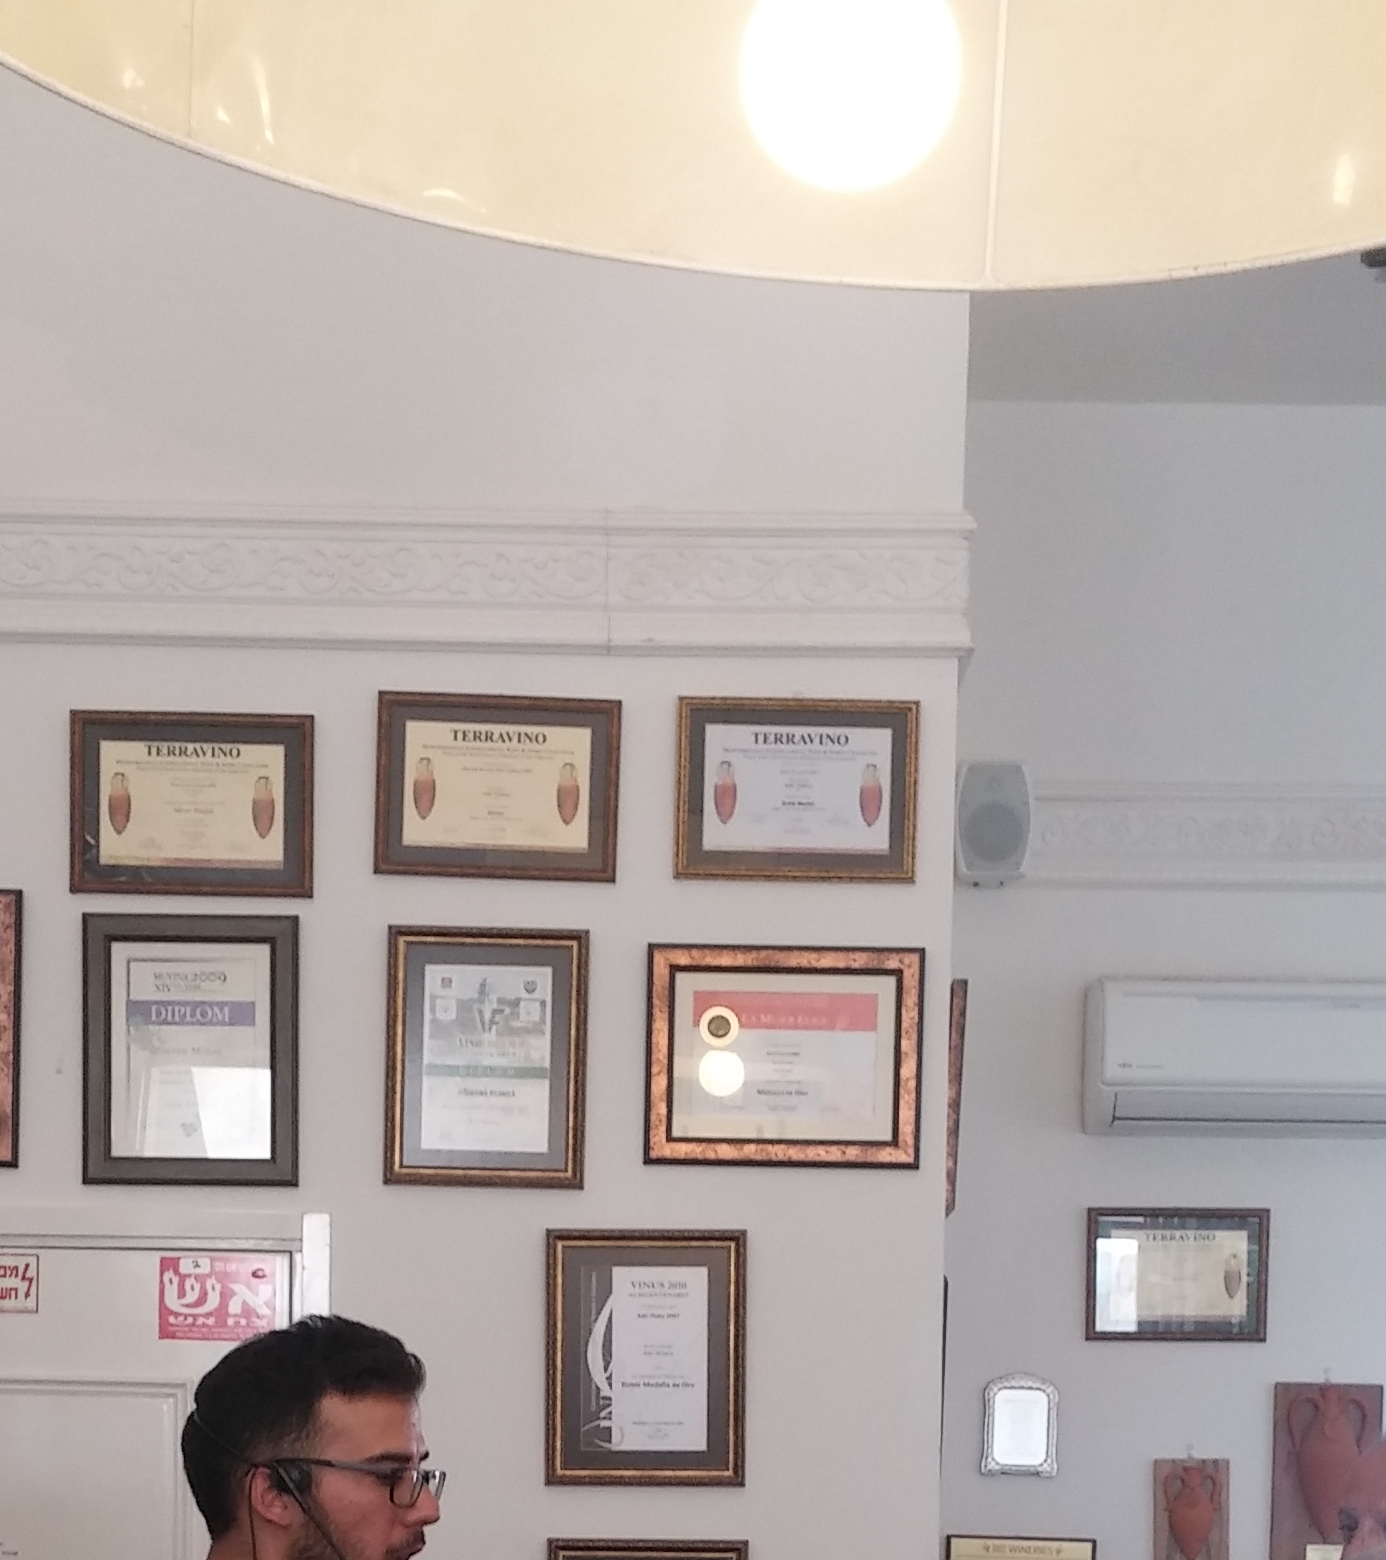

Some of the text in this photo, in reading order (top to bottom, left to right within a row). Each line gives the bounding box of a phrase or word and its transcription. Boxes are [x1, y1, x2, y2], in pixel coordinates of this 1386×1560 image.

[450, 729, 547, 745] TERRAVINO
[752, 731, 849, 746] TERRAVINO
[144, 744, 241, 759] TERRAVINO
[151, 1005, 230, 1023] DIPLOM
[1144, 1232, 1216, 1244] TERRAVINO
